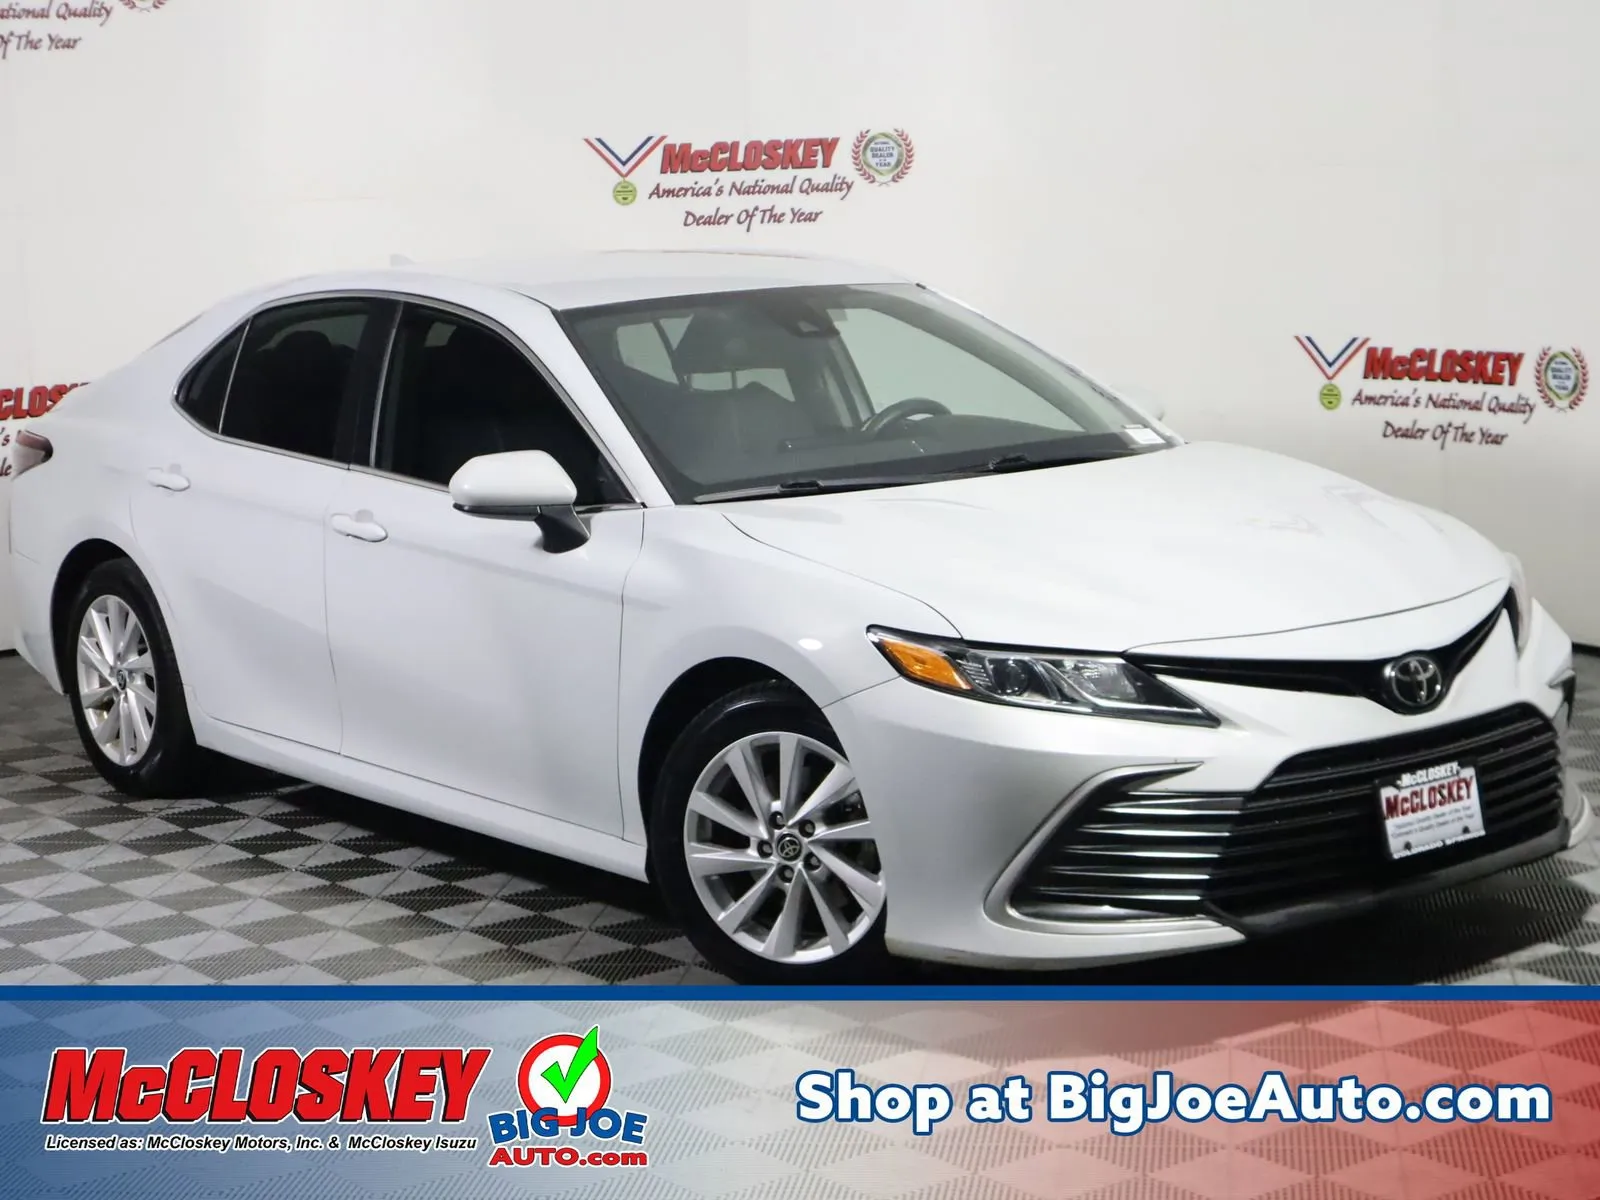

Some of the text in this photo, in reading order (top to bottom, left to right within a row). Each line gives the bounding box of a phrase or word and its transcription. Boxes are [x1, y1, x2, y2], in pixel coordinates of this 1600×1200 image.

[0, 0, 113, 27] ational Quality
[15, 30, 43, 50] The
[48, 33, 82, 51] Year
[660, 137, 840, 174] McCLOSKEY
[648, 178, 724, 199] America's
[728, 176, 796, 196] National
[799, 173, 854, 200] Quality
[683, 204, 823, 232] Dealer Of The Year
[1363, 347, 1524, 386] McCLOSKEY
[1351, 387, 1422, 408] America's
[1425, 390, 1484, 412] National
[1488, 394, 1536, 424] Quality
[1382, 420, 1509, 450] Dealer Of The Year
[1385, 776, 1473, 819] McCLOSKEY
